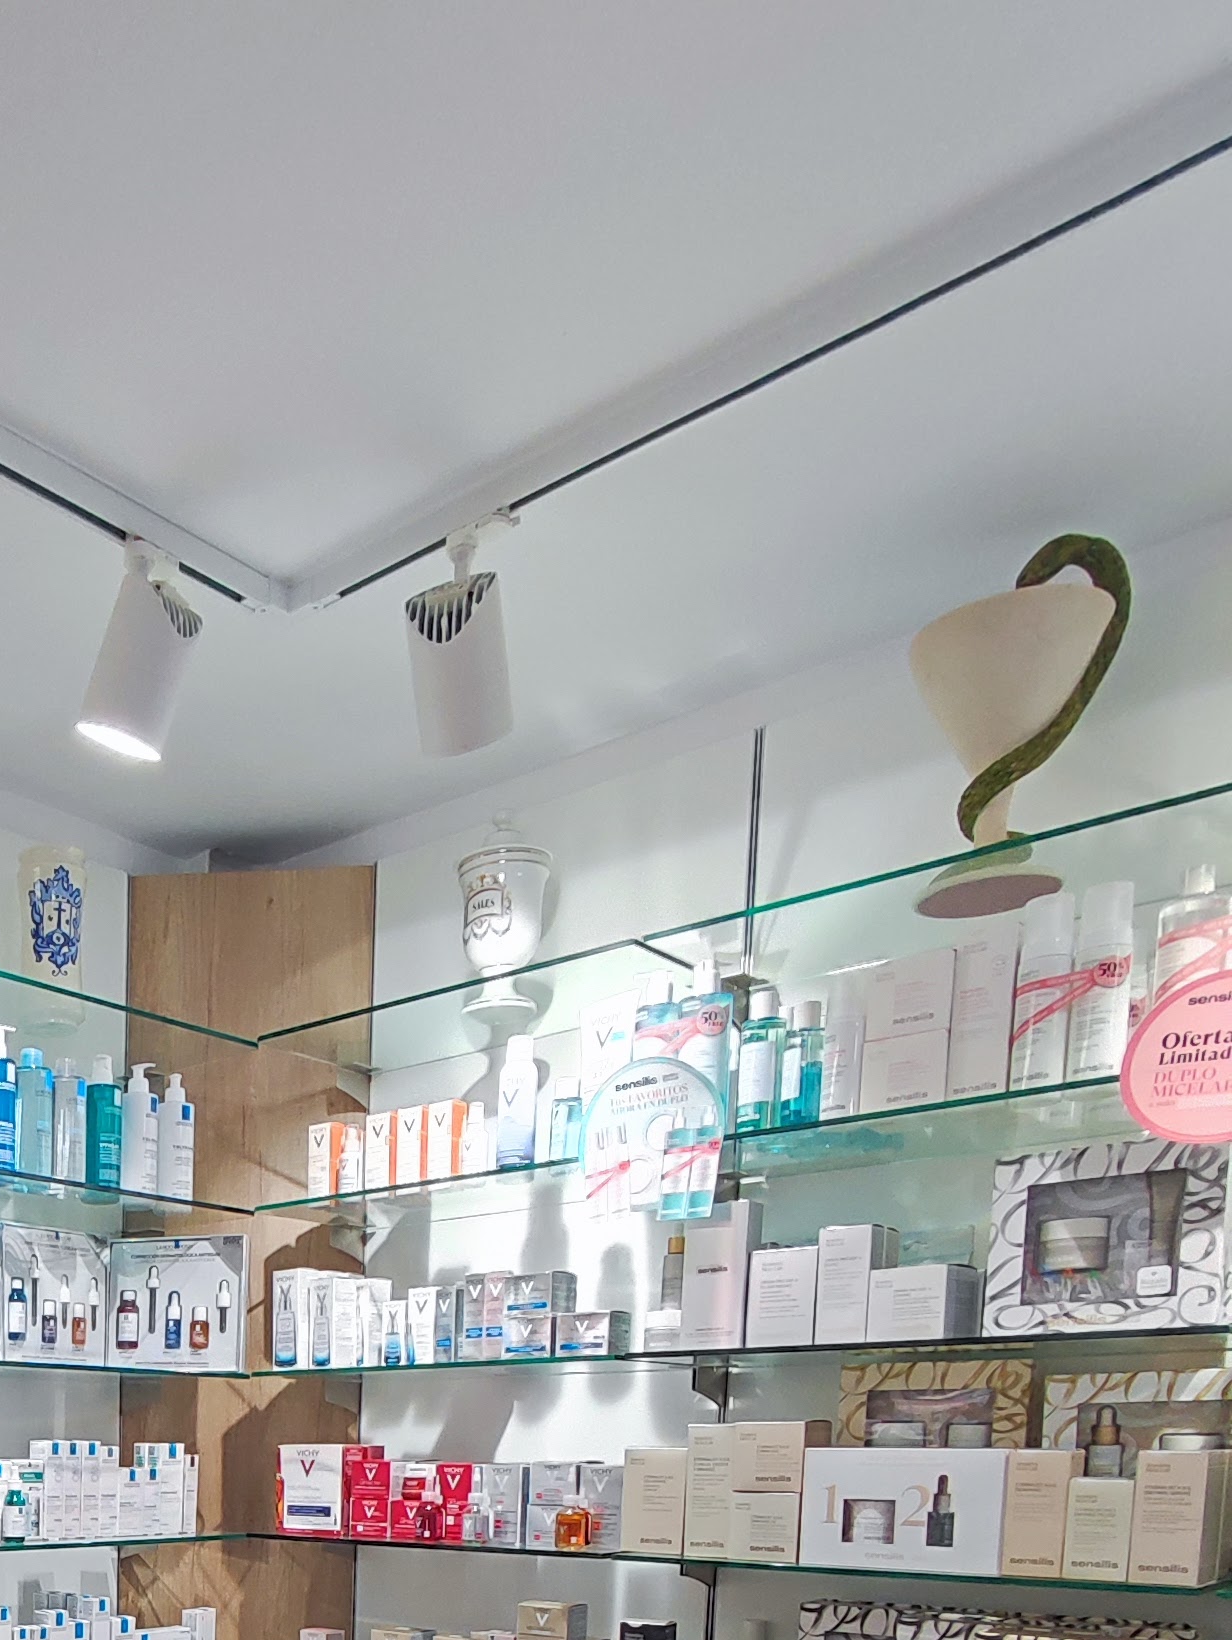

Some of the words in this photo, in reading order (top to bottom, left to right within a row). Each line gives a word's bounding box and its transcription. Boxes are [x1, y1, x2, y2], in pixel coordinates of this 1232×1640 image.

[1161, 1030, 1232, 1050] Oferta
[615, 1076, 658, 1092] sensilis
[1154, 1068, 1217, 1085] DUPLO
[899, 1485, 931, 1527] 2
[1010, 1556, 1054, 1567] sensilis
[1071, 1560, 1119, 1569] sensilis
[1138, 1564, 1189, 1574] sensilis
